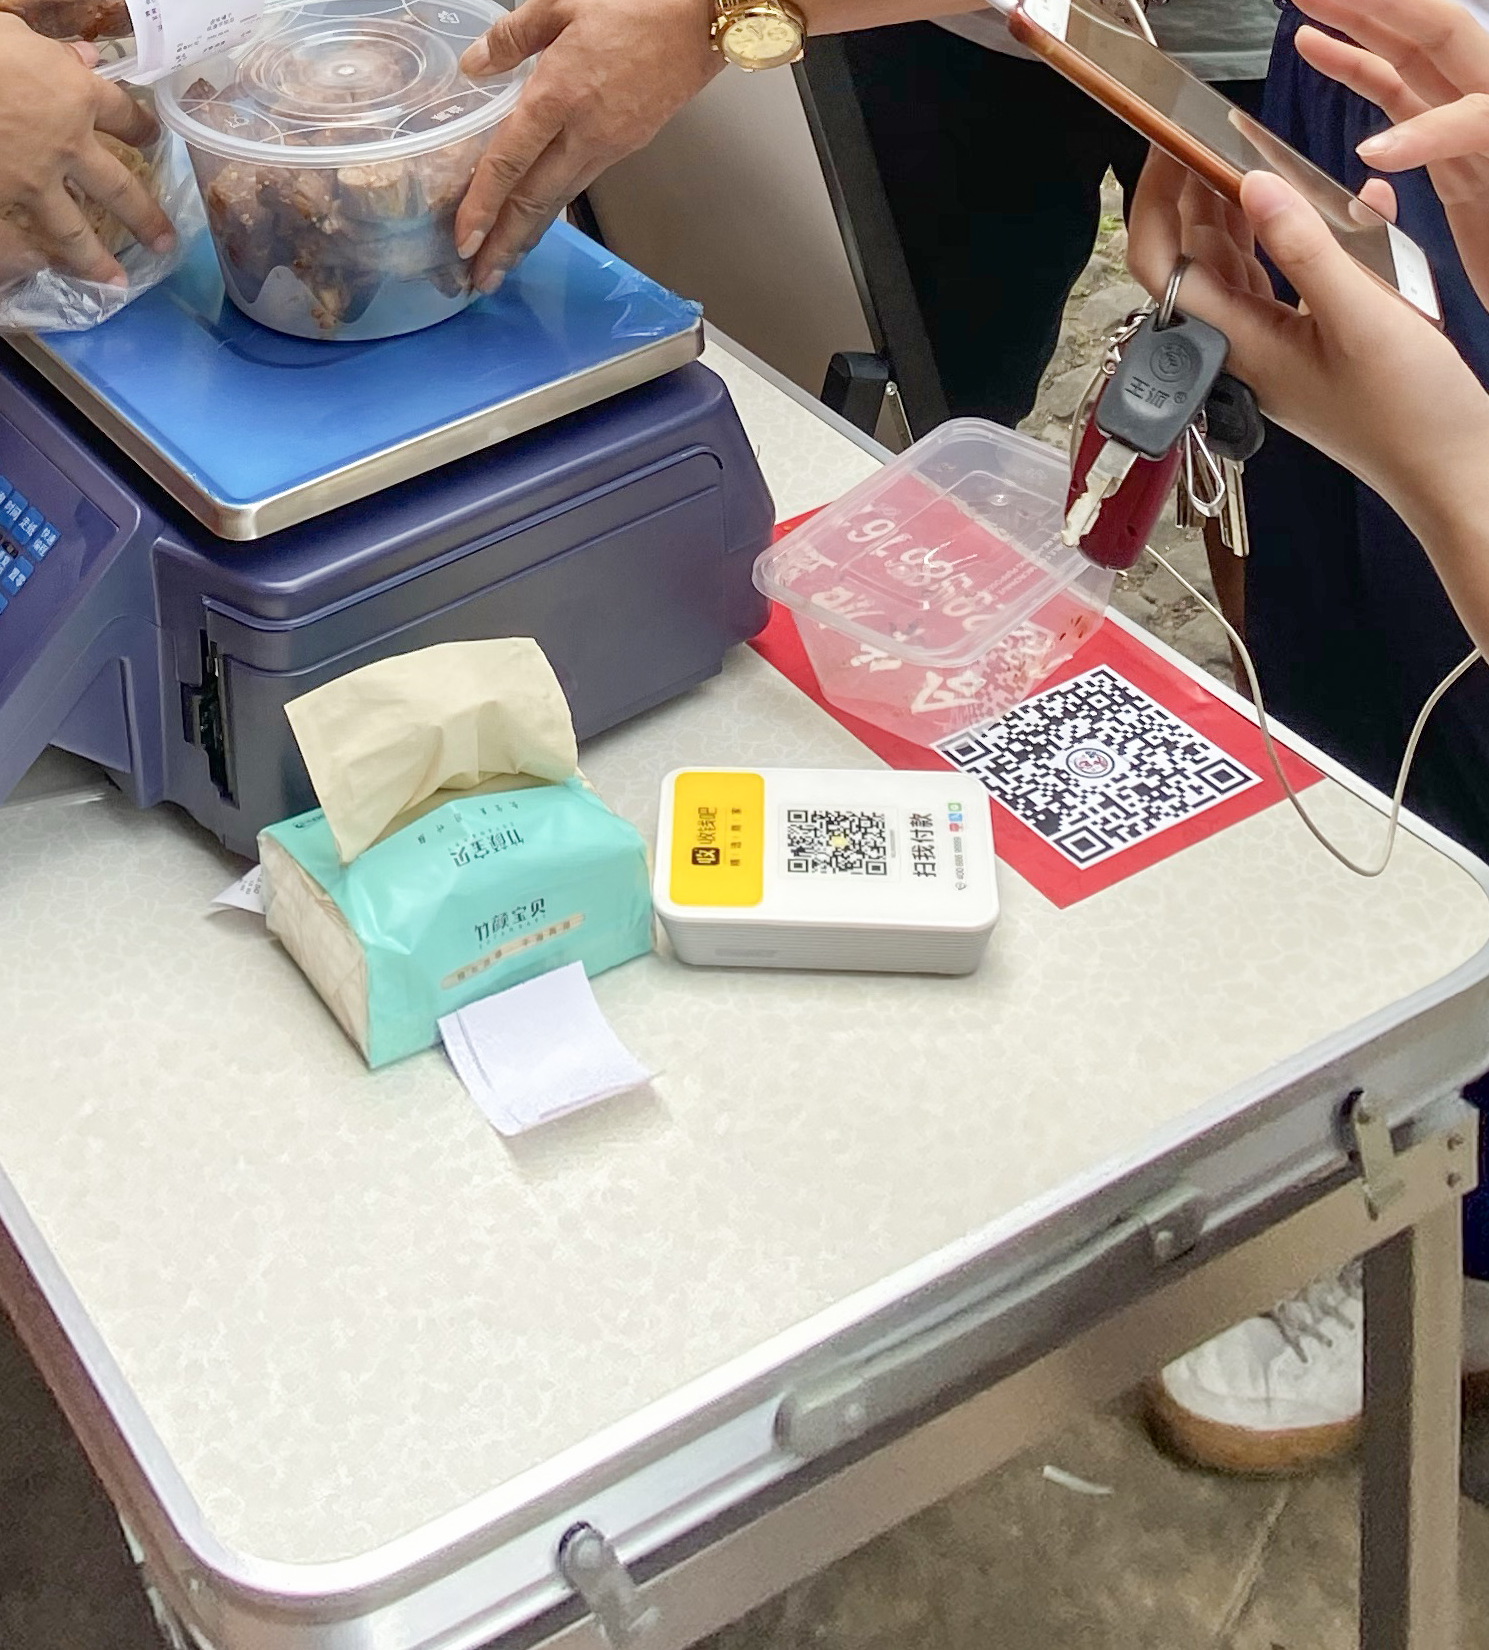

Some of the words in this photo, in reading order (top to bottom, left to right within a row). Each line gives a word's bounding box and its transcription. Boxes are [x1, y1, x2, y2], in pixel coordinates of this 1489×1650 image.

[697, 807, 718, 846] 收钱吧
[909, 811, 938, 878] 扫我付款
[474, 897, 546, 942] 竹颜宝贝
